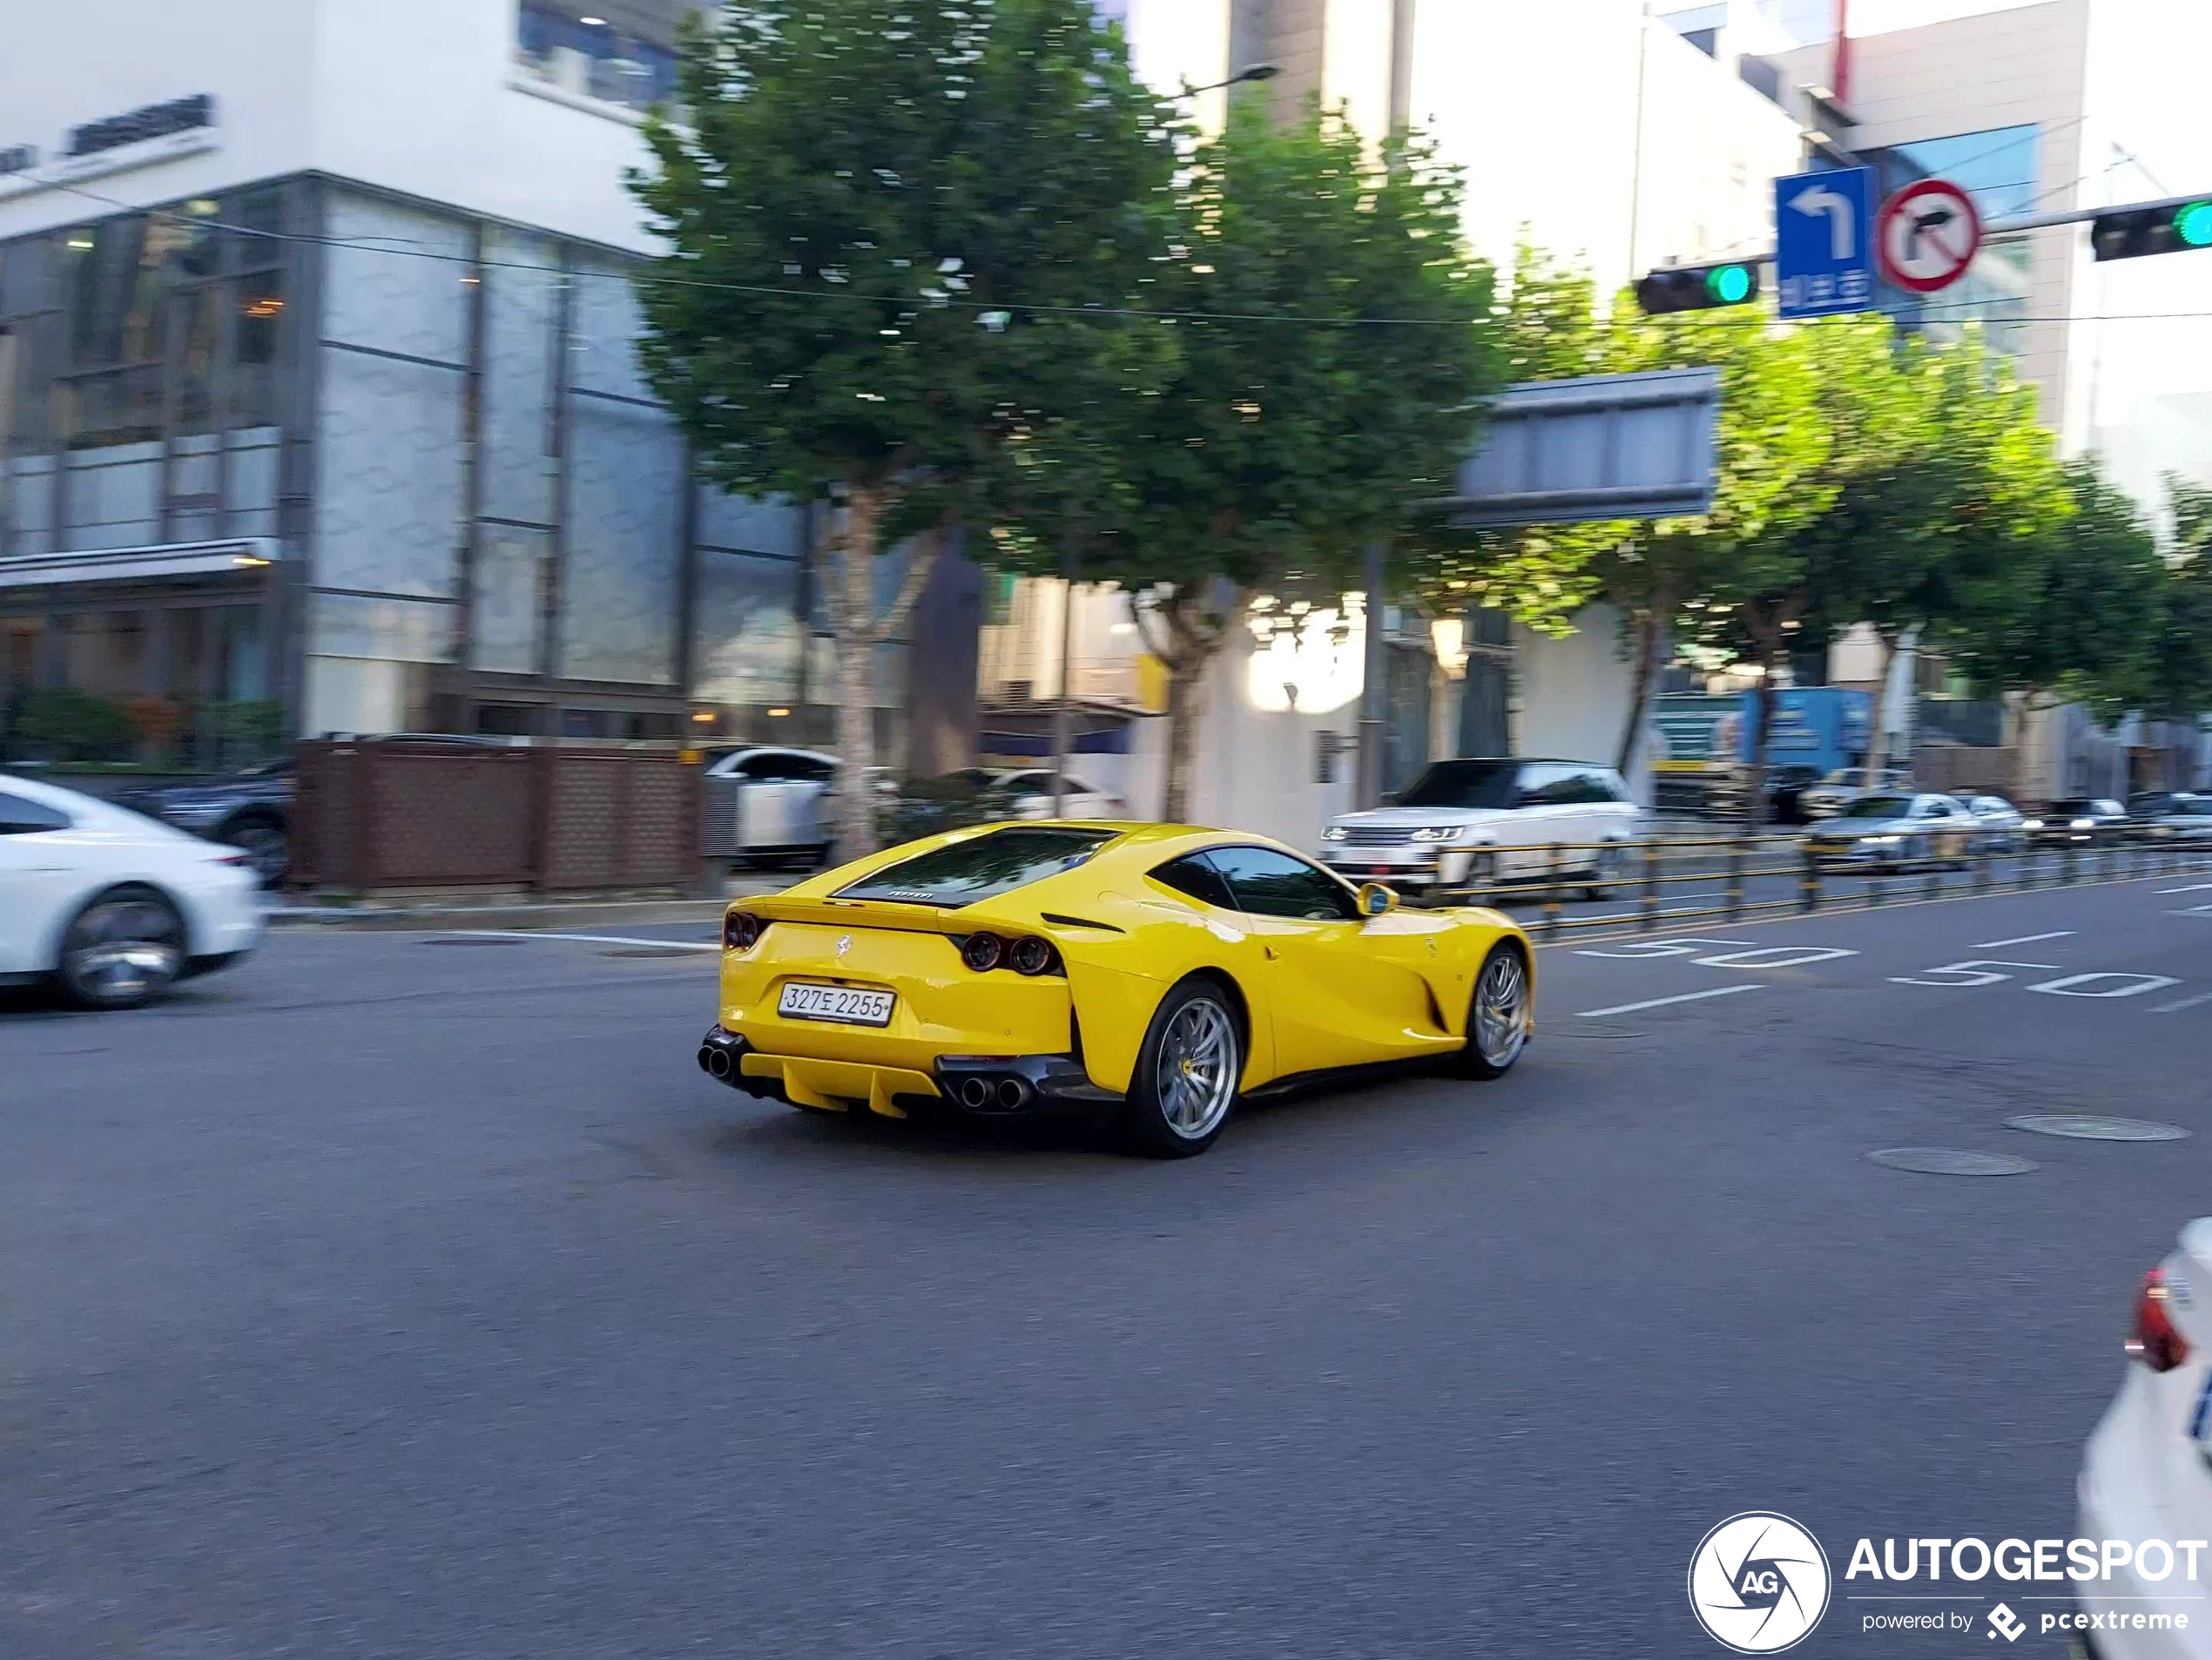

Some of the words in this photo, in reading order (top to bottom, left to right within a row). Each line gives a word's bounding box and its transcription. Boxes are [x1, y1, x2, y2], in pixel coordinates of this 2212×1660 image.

[1571, 938, 1861, 968] 50
[1886, 961, 2184, 998] 50
[786, 988, 833, 1010] 327도
[835, 992, 885, 1017] 2255
